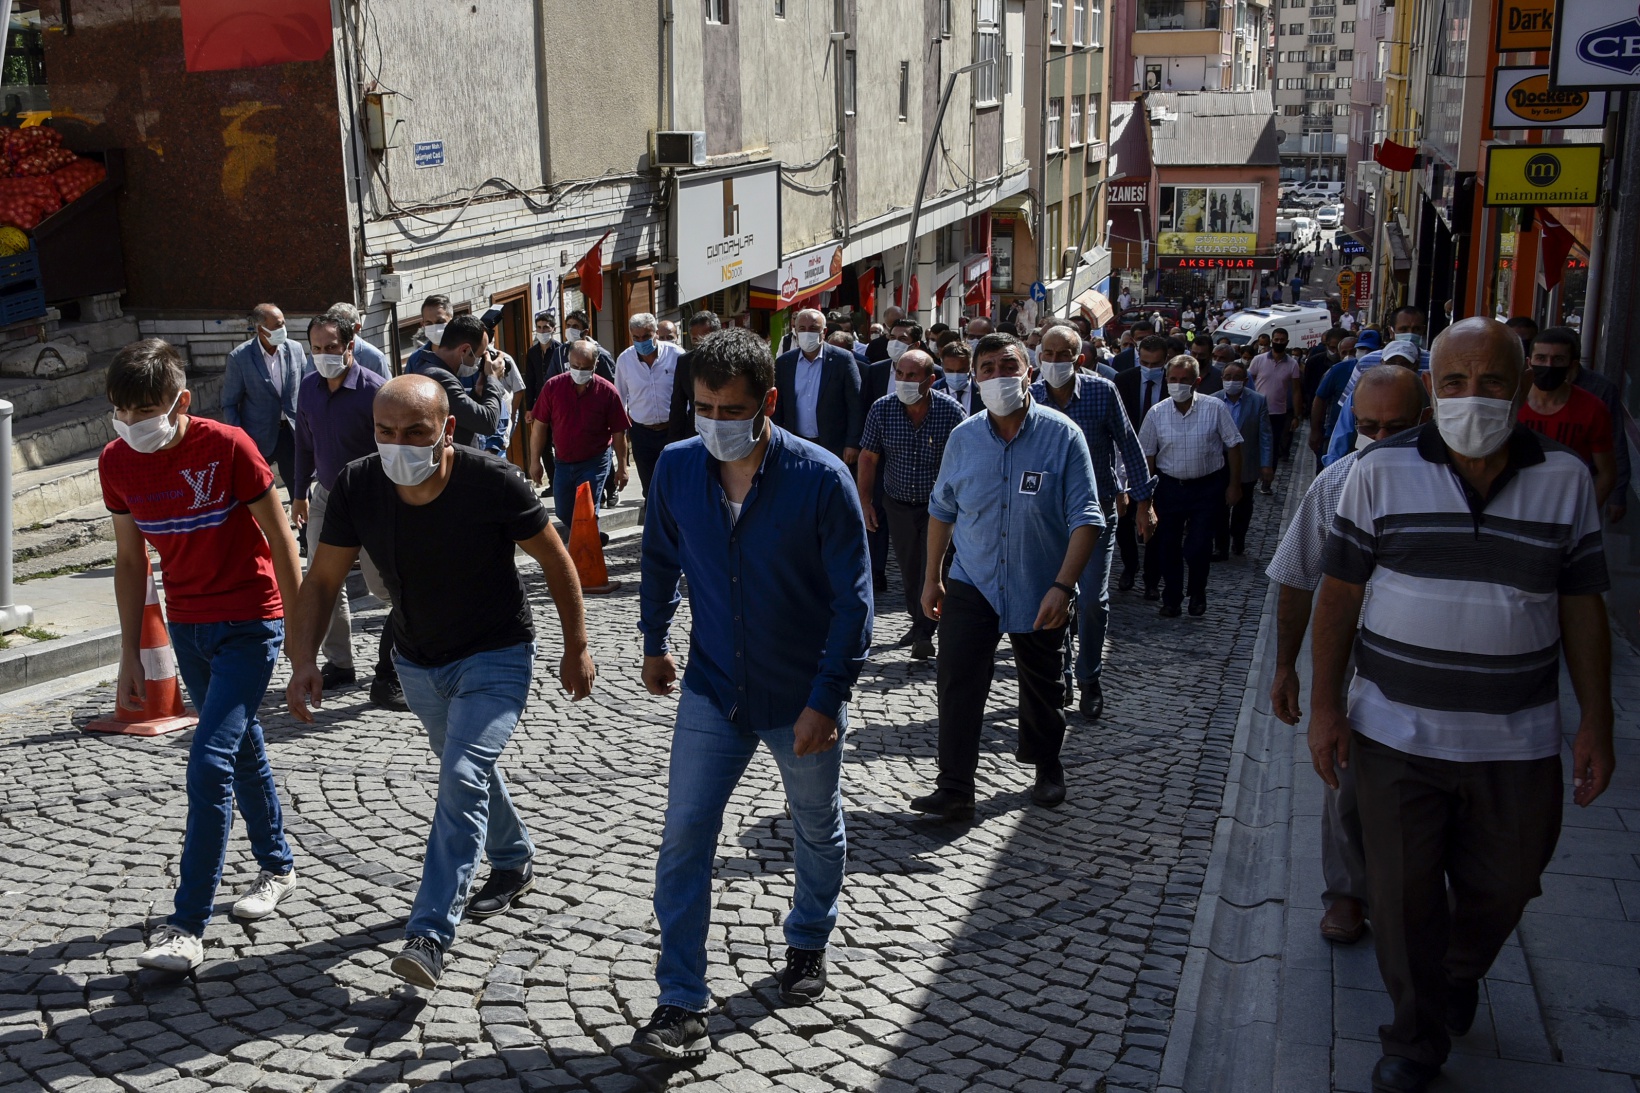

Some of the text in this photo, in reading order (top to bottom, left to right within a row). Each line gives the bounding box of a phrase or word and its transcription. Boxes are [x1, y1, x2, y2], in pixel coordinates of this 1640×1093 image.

[1511, 89, 1584, 108] Dockers
[1531, 108, 1542, 116] by
[1495, 187, 1589, 201] mammamia
[1194, 234, 1248, 244] GÜLCAN
[1194, 243, 1247, 253] KUAFÖR
[1179, 259, 1254, 267] AKSESUAR
[1306, 339, 1317, 348] 112
